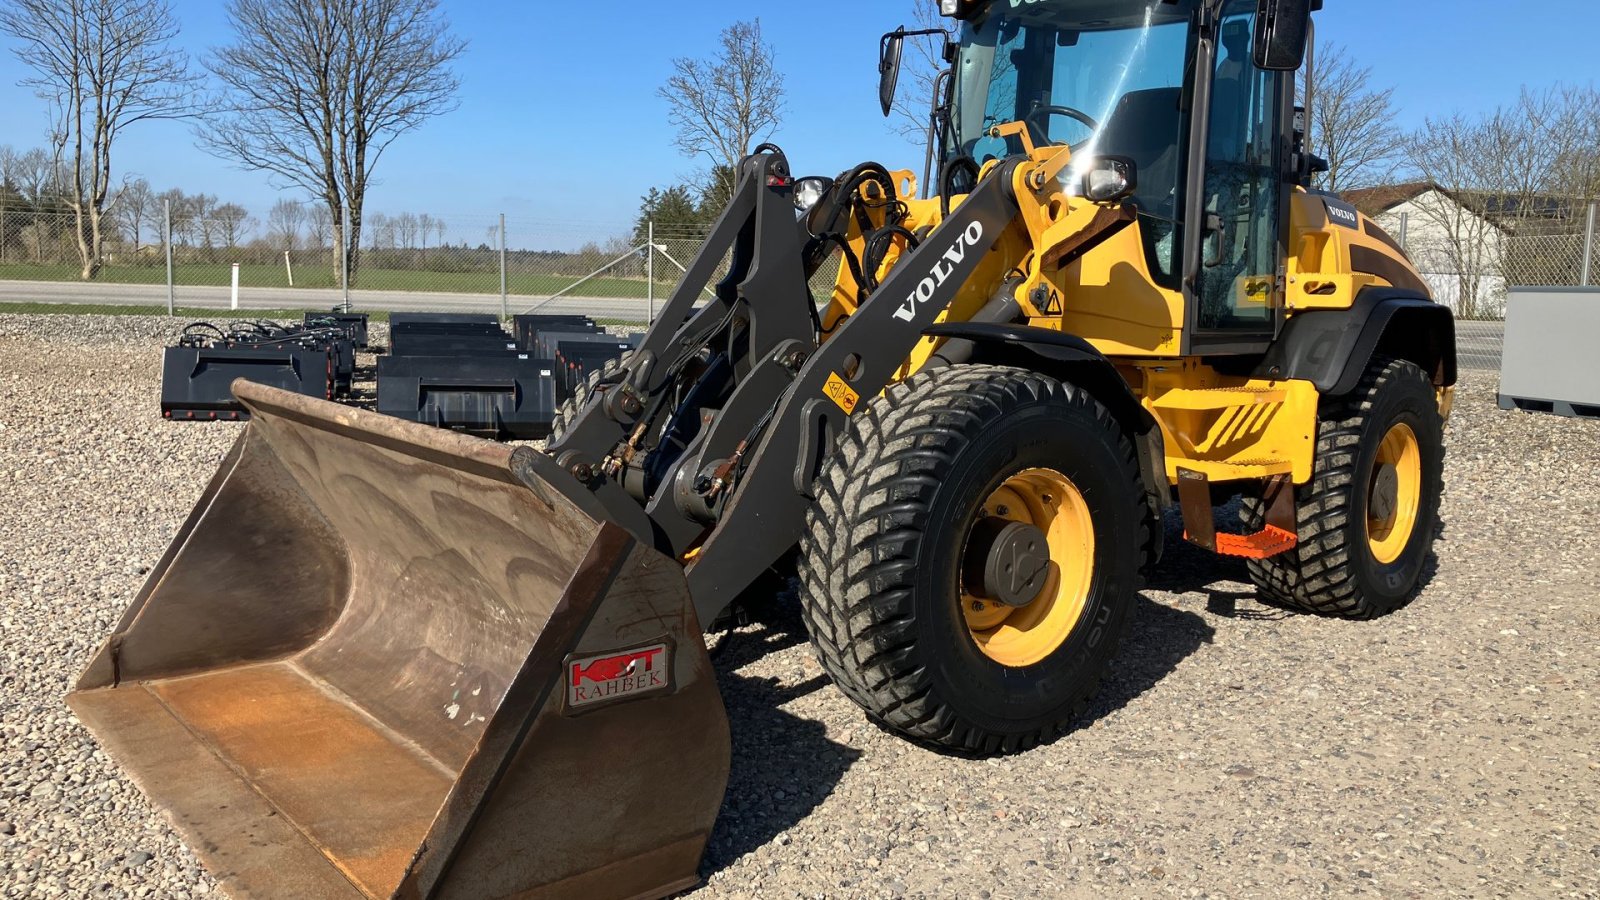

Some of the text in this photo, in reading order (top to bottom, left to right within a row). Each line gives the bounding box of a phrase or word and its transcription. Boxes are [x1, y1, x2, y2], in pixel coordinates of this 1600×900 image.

[1328, 205, 1356, 222] VOLVO
[892, 220, 983, 323] VOLVO
[575, 671, 662, 702] RAHBEK
